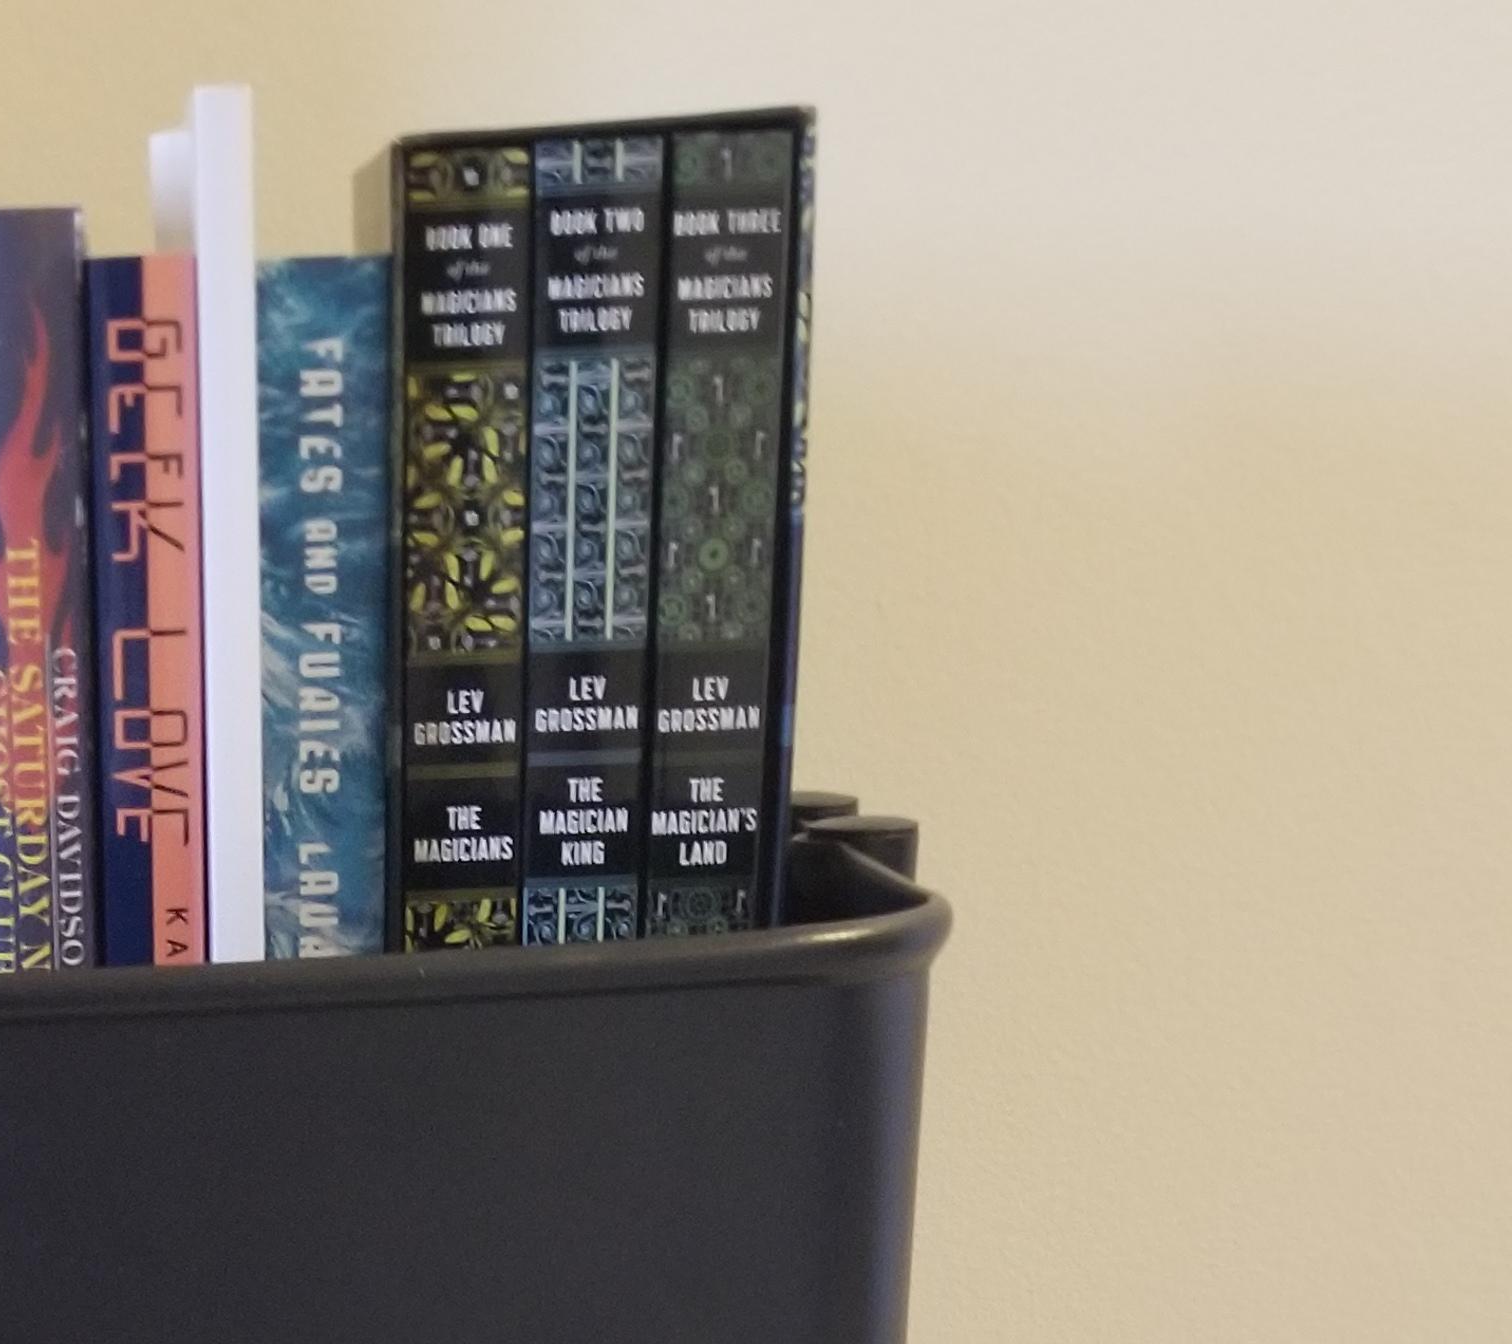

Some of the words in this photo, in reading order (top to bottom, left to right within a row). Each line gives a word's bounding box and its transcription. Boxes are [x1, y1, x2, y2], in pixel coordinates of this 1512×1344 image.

[298, 336, 345, 495] FATES
[105, 317, 185, 563] GEEK
[302, 517, 339, 596] AND
[4, 537, 43, 646] THE
[445, 688, 486, 716] LEV
[567, 675, 608, 703] LEV
[691, 675, 731, 703] LEV
[51, 647, 80, 778] CRAIG
[533, 704, 640, 734] GROSSMAN
[656, 705, 762, 734] GROSSMAN
[112, 624, 190, 847] LOVE
[412, 718, 518, 747] GROSSMAN
[10, 663, 52, 927] SATURDAY
[565, 775, 605, 804] THE
[687, 776, 727, 804] THE
[445, 805, 483, 833] THE
[538, 806, 630, 837] MAGICIAN
[649, 806, 760, 837] MAGICIAN'S
[412, 835, 515, 864] MAGICIANS
[560, 840, 606, 868] KING
[677, 840, 730, 868] LAND
[56, 794, 86, 967] DAVIDSO
